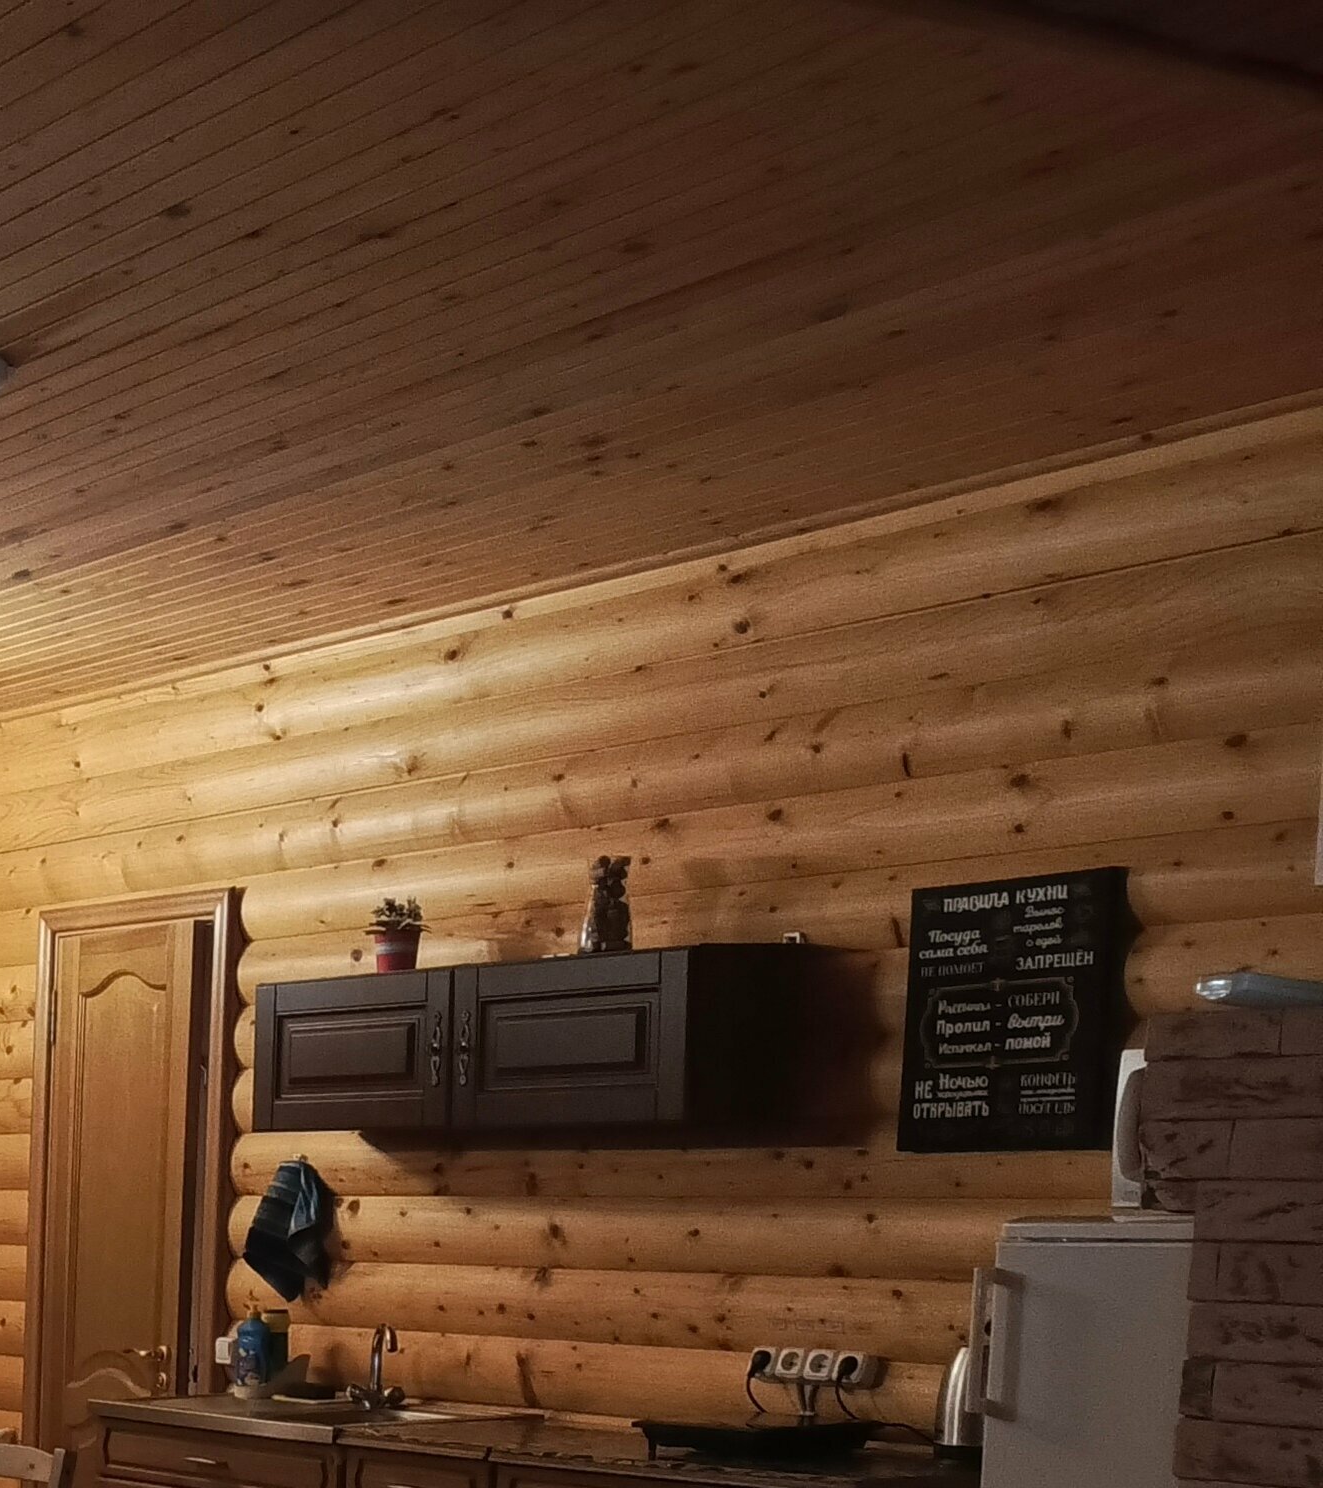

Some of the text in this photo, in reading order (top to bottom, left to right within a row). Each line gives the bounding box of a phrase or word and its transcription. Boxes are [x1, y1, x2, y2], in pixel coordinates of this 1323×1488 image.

[943, 884, 1068, 913] ПРАВИЛА КУХНИ
[928, 929, 981, 946] Посуда
[919, 947, 954, 959] сама
[1008, 990, 1060, 1008] СОБЕРИ
[936, 1019, 991, 1038] Пролил
[914, 1080, 934, 1099] НЕ
[938, 1072, 989, 1090] Ночью
[913, 1100, 990, 1119] ОТКРЫВАТЬ
